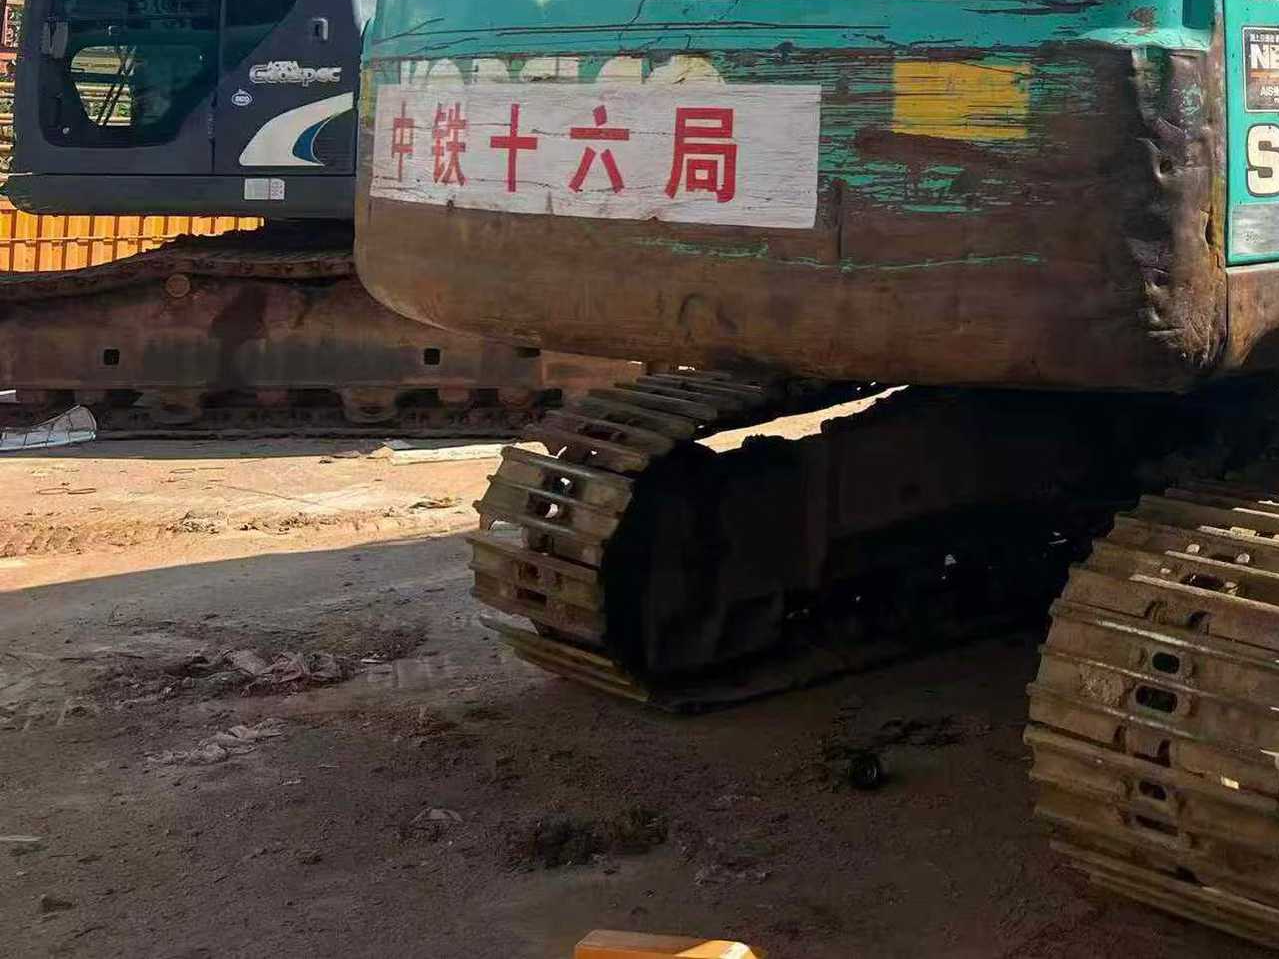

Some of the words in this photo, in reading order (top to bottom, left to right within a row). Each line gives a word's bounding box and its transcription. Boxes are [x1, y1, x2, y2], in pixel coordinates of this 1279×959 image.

[391, 100, 738, 203] 中铁十六局
